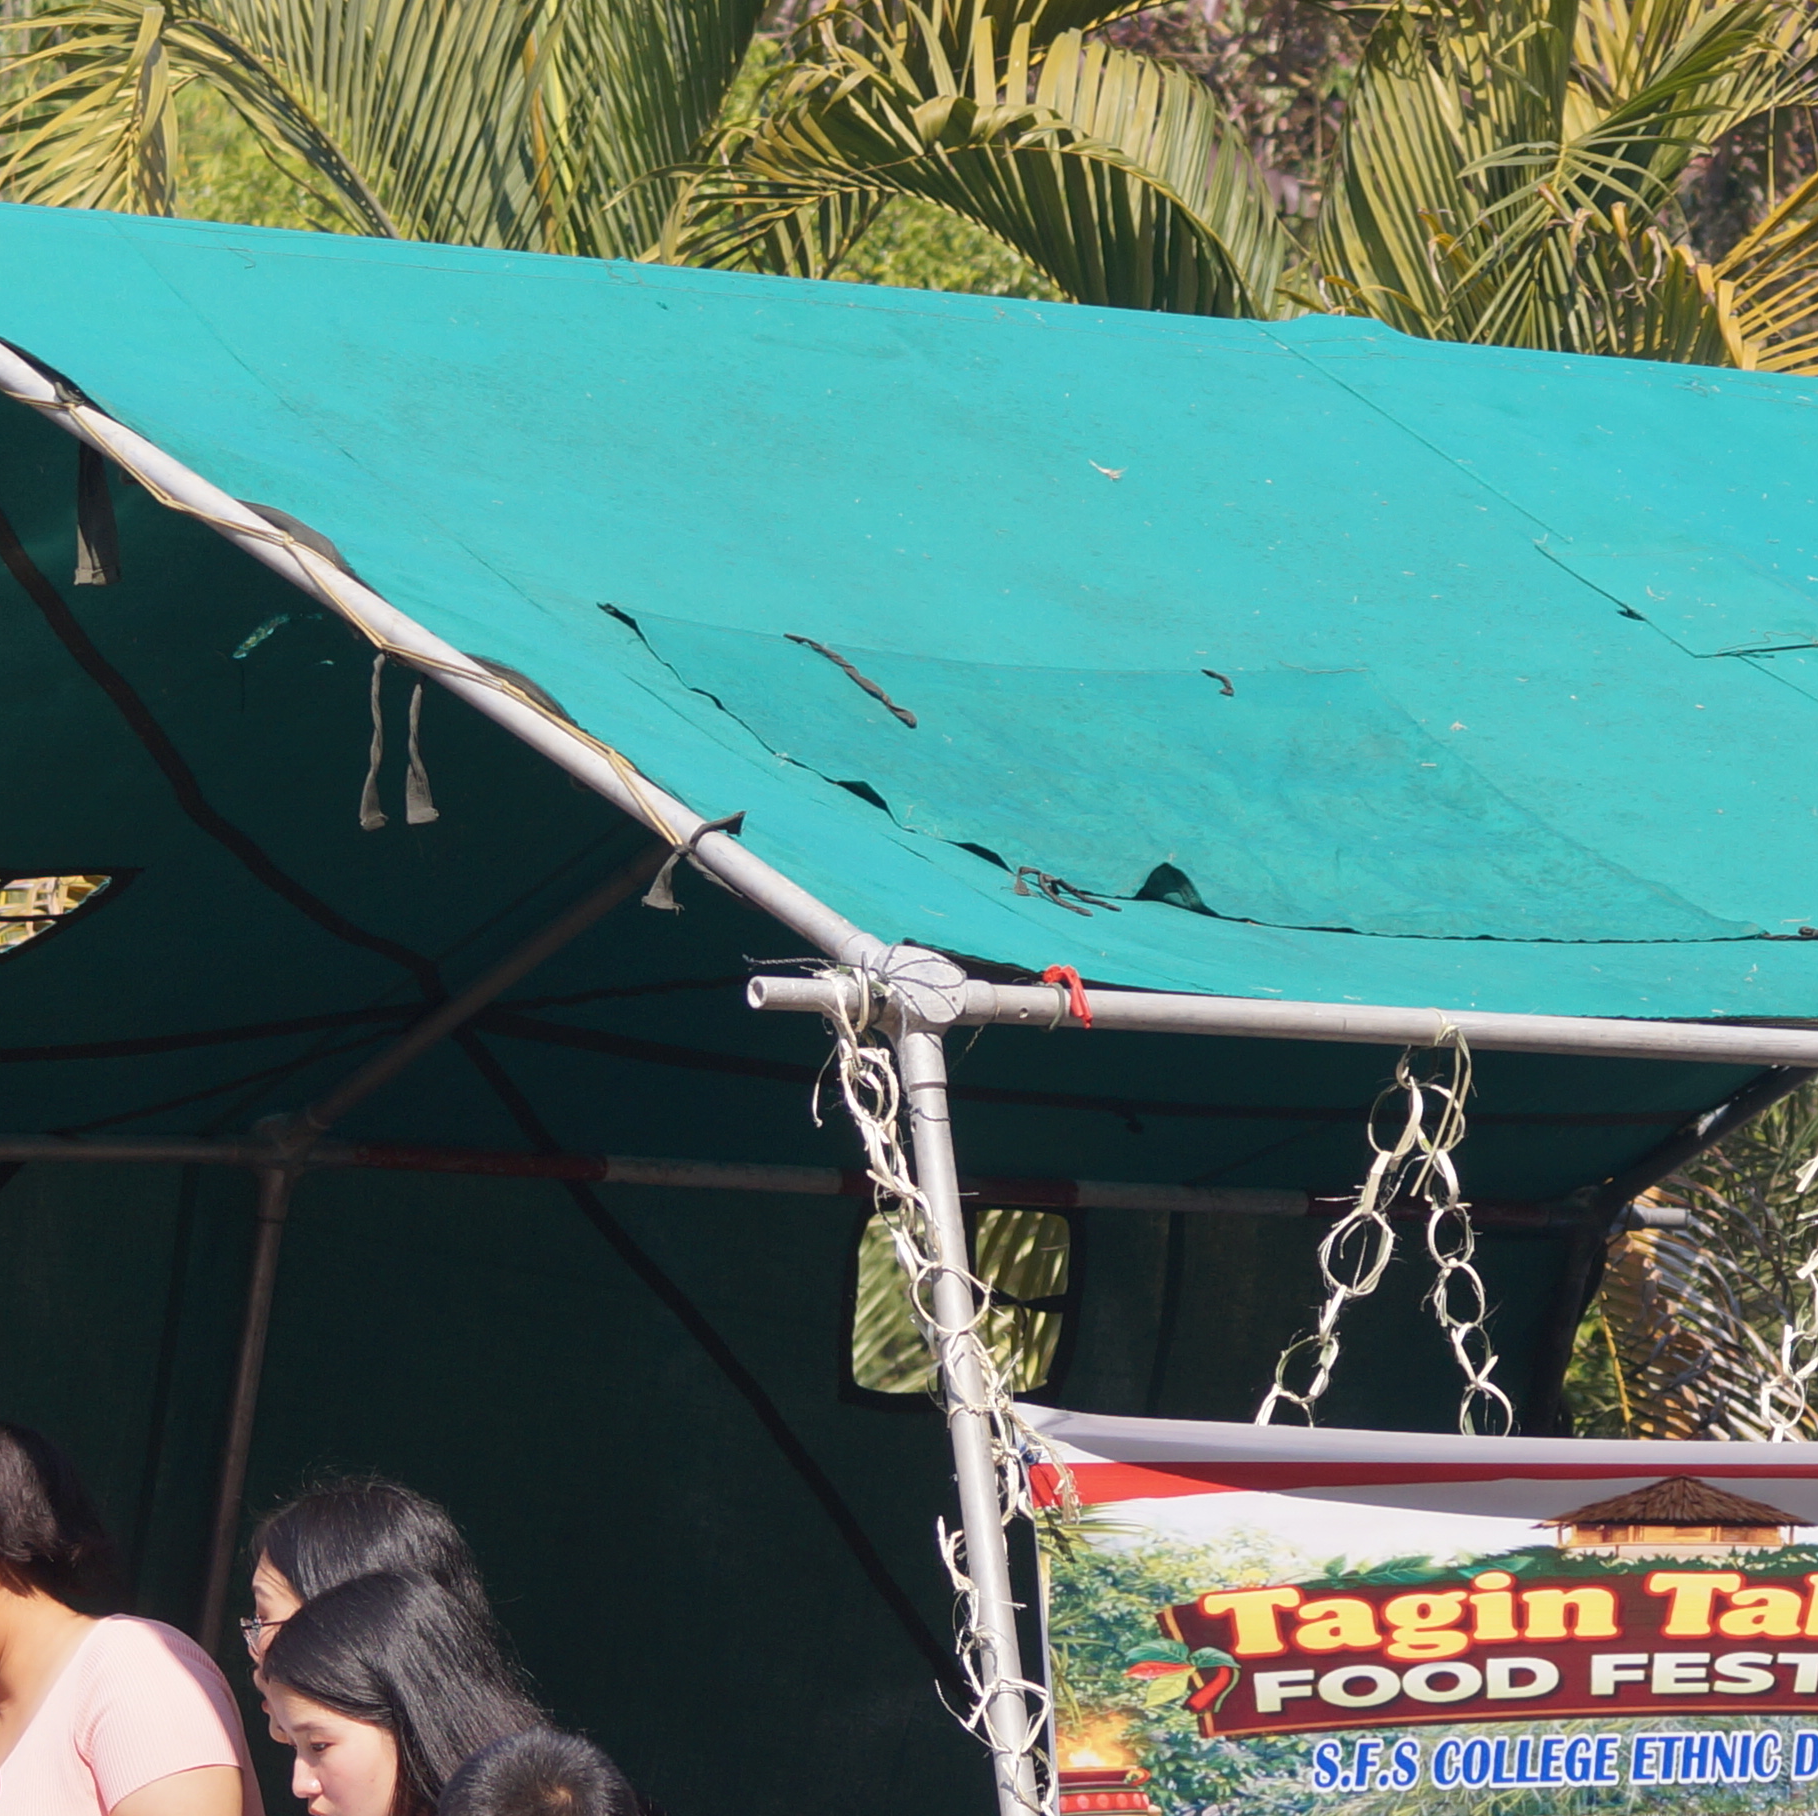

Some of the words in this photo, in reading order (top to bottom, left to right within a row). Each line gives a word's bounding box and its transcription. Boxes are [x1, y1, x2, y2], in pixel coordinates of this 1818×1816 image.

[1202, 1570, 1621, 1661] Tagin
[1253, 1656, 1560, 1713] FOOD
[1313, 1738, 1420, 1790] S.F.S
[1433, 1735, 1619, 1788] COLLEGE
[1632, 1730, 1781, 1783] ETHNIC
